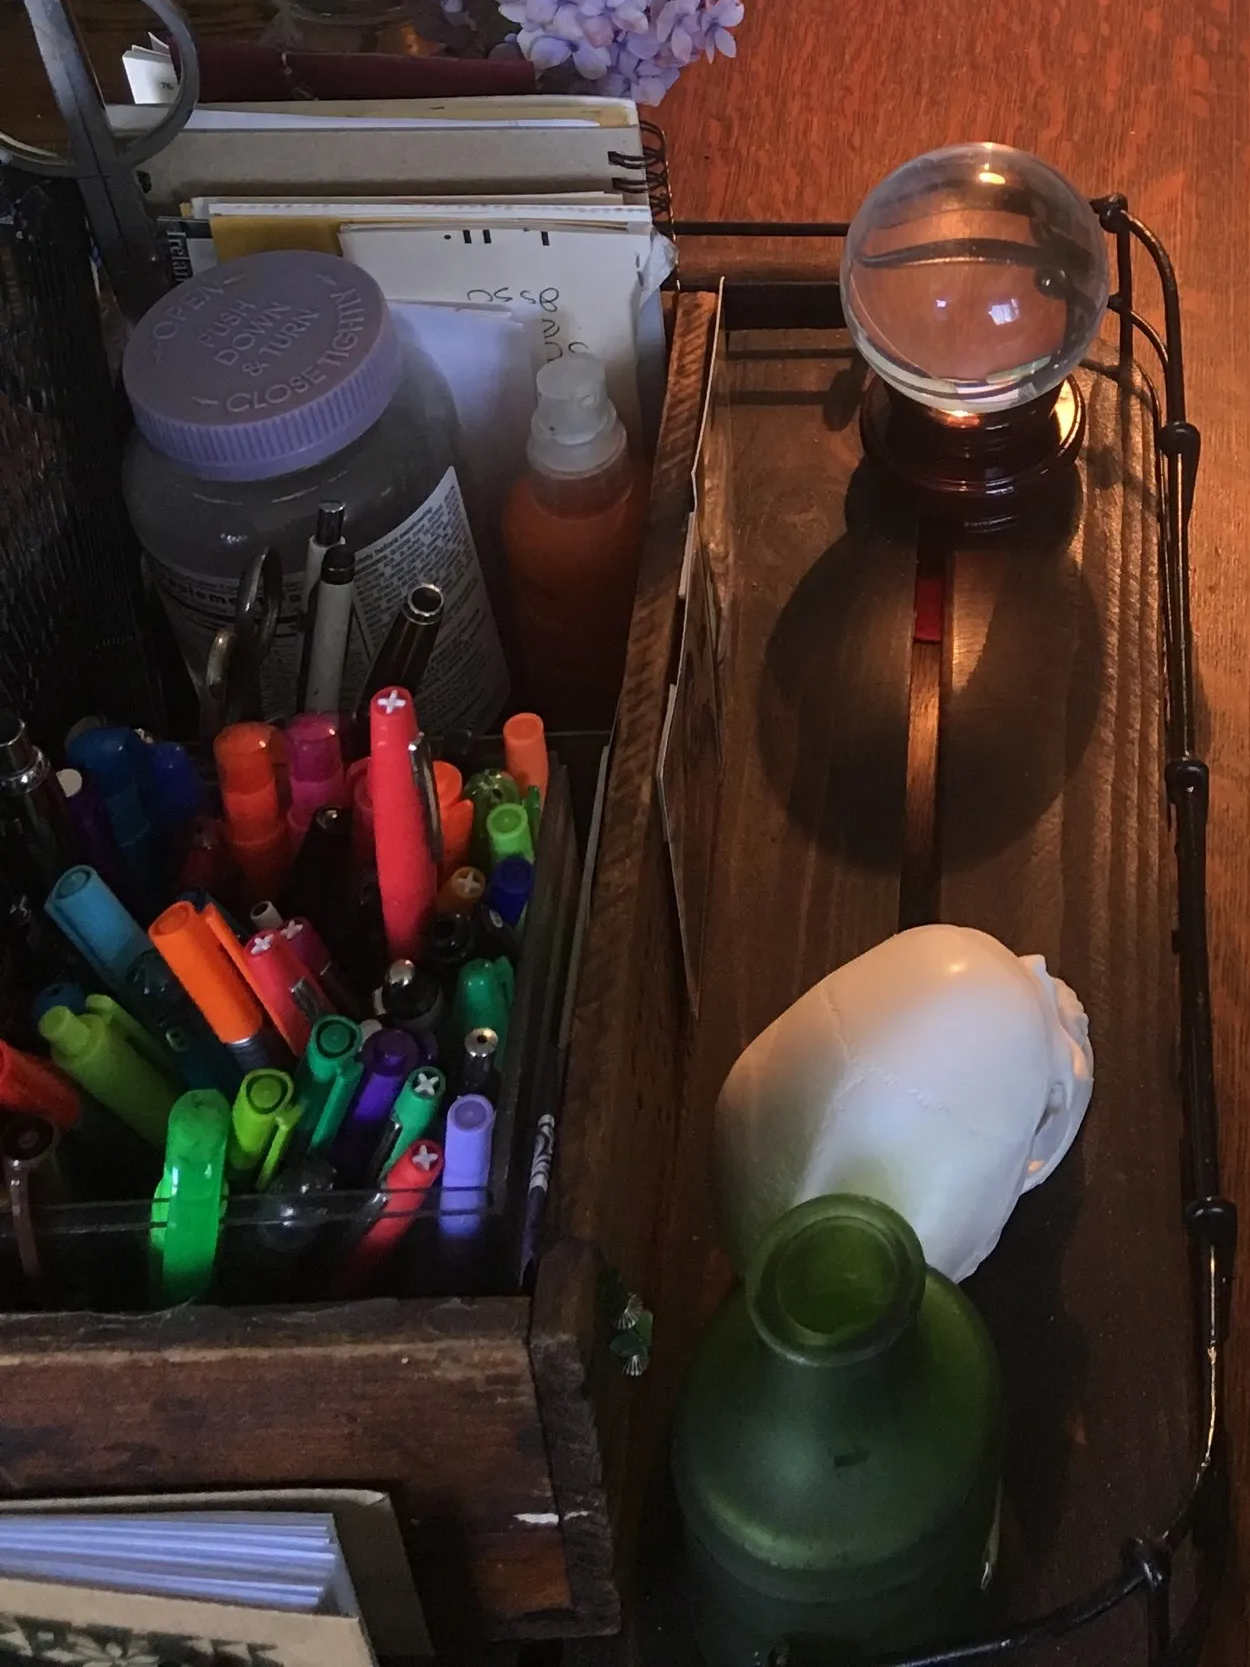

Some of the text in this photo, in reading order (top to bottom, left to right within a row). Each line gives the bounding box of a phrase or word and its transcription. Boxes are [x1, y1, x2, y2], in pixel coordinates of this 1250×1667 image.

[152, 280, 226, 342] OPEN
[199, 298, 257, 348] PUSH
[213, 300, 292, 367] DOWN
[242, 307, 320, 377] & TURN
[226, 287, 365, 414] CLOSE TIGHTLY
